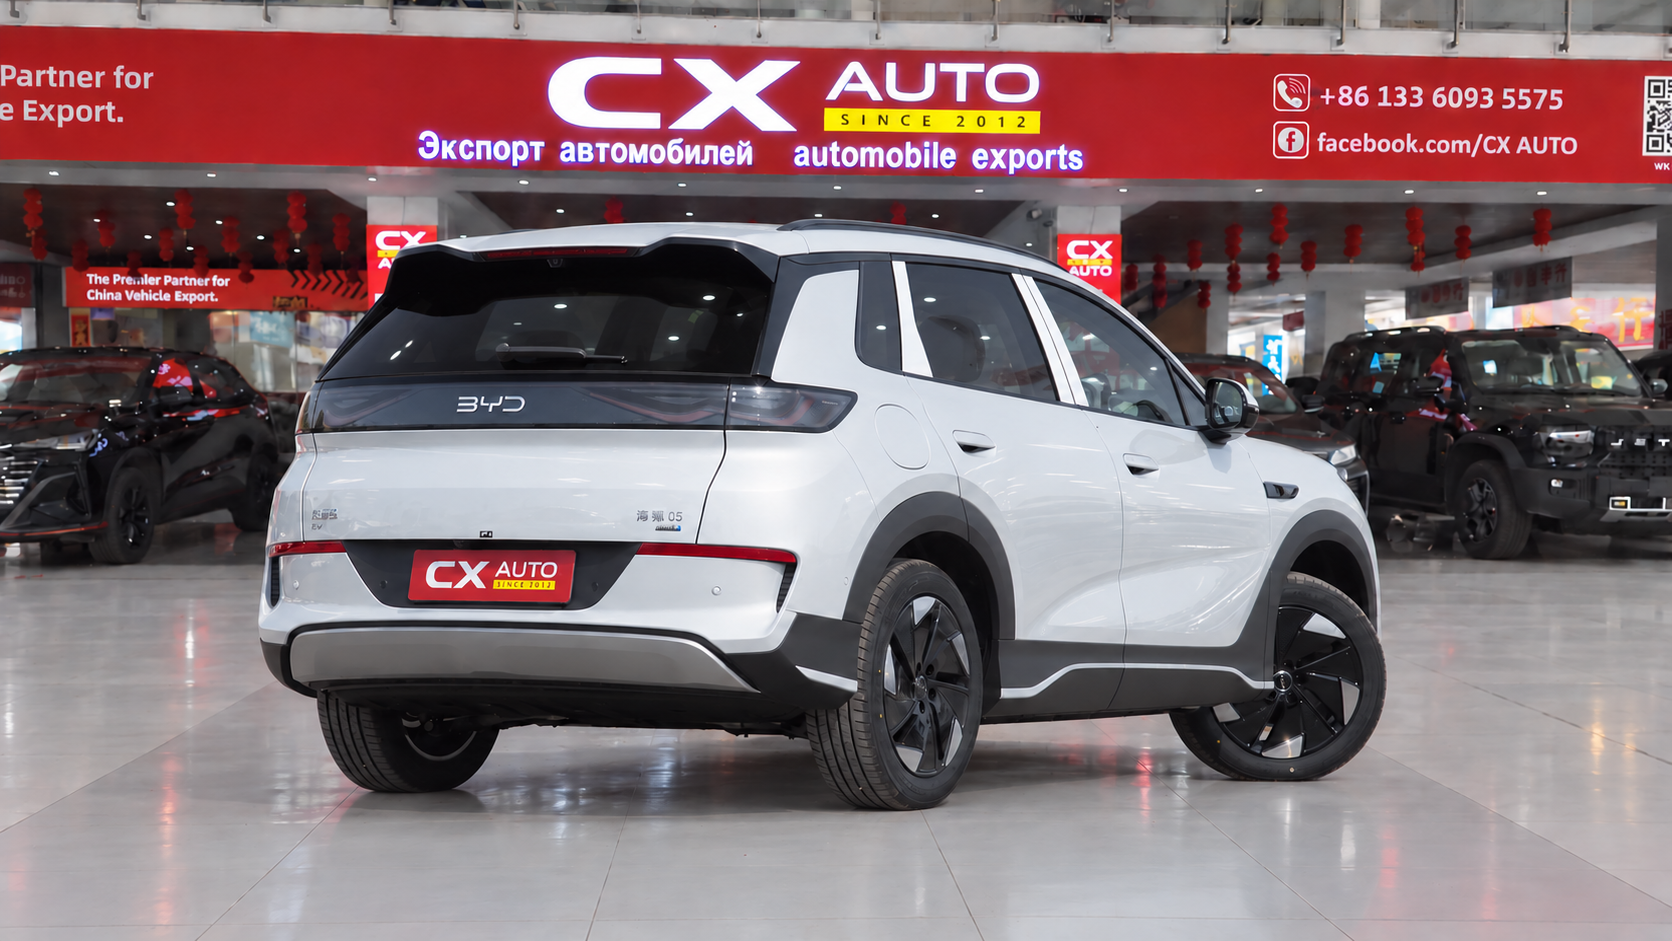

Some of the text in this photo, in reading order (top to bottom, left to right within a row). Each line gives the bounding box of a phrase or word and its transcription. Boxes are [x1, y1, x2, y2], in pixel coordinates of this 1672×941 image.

[0, 65, 154, 88] Partner for
[547, 56, 1041, 132] CX AUTO
[1320, 86, 1563, 110] +86 133 6093 5575
[23, 99, 124, 127] Export.
[841, 114, 1026, 128] SINCE 2012
[417, 130, 753, 167] Экспорт автомобилей
[1316, 131, 1578, 158] facebook.com/CX AUTO
[793, 140, 1084, 174] automobile exports
[375, 230, 427, 251] CX
[1066, 239, 1114, 260] CX
[86, 273, 231, 287] The Premier Partner for
[1068, 265, 1113, 277] AUTO
[86, 288, 219, 304] China Vehicle Export.
[456, 396, 526, 413] BYD
[668, 511, 683, 522] 05
[425, 560, 558, 589] CX AUTO
